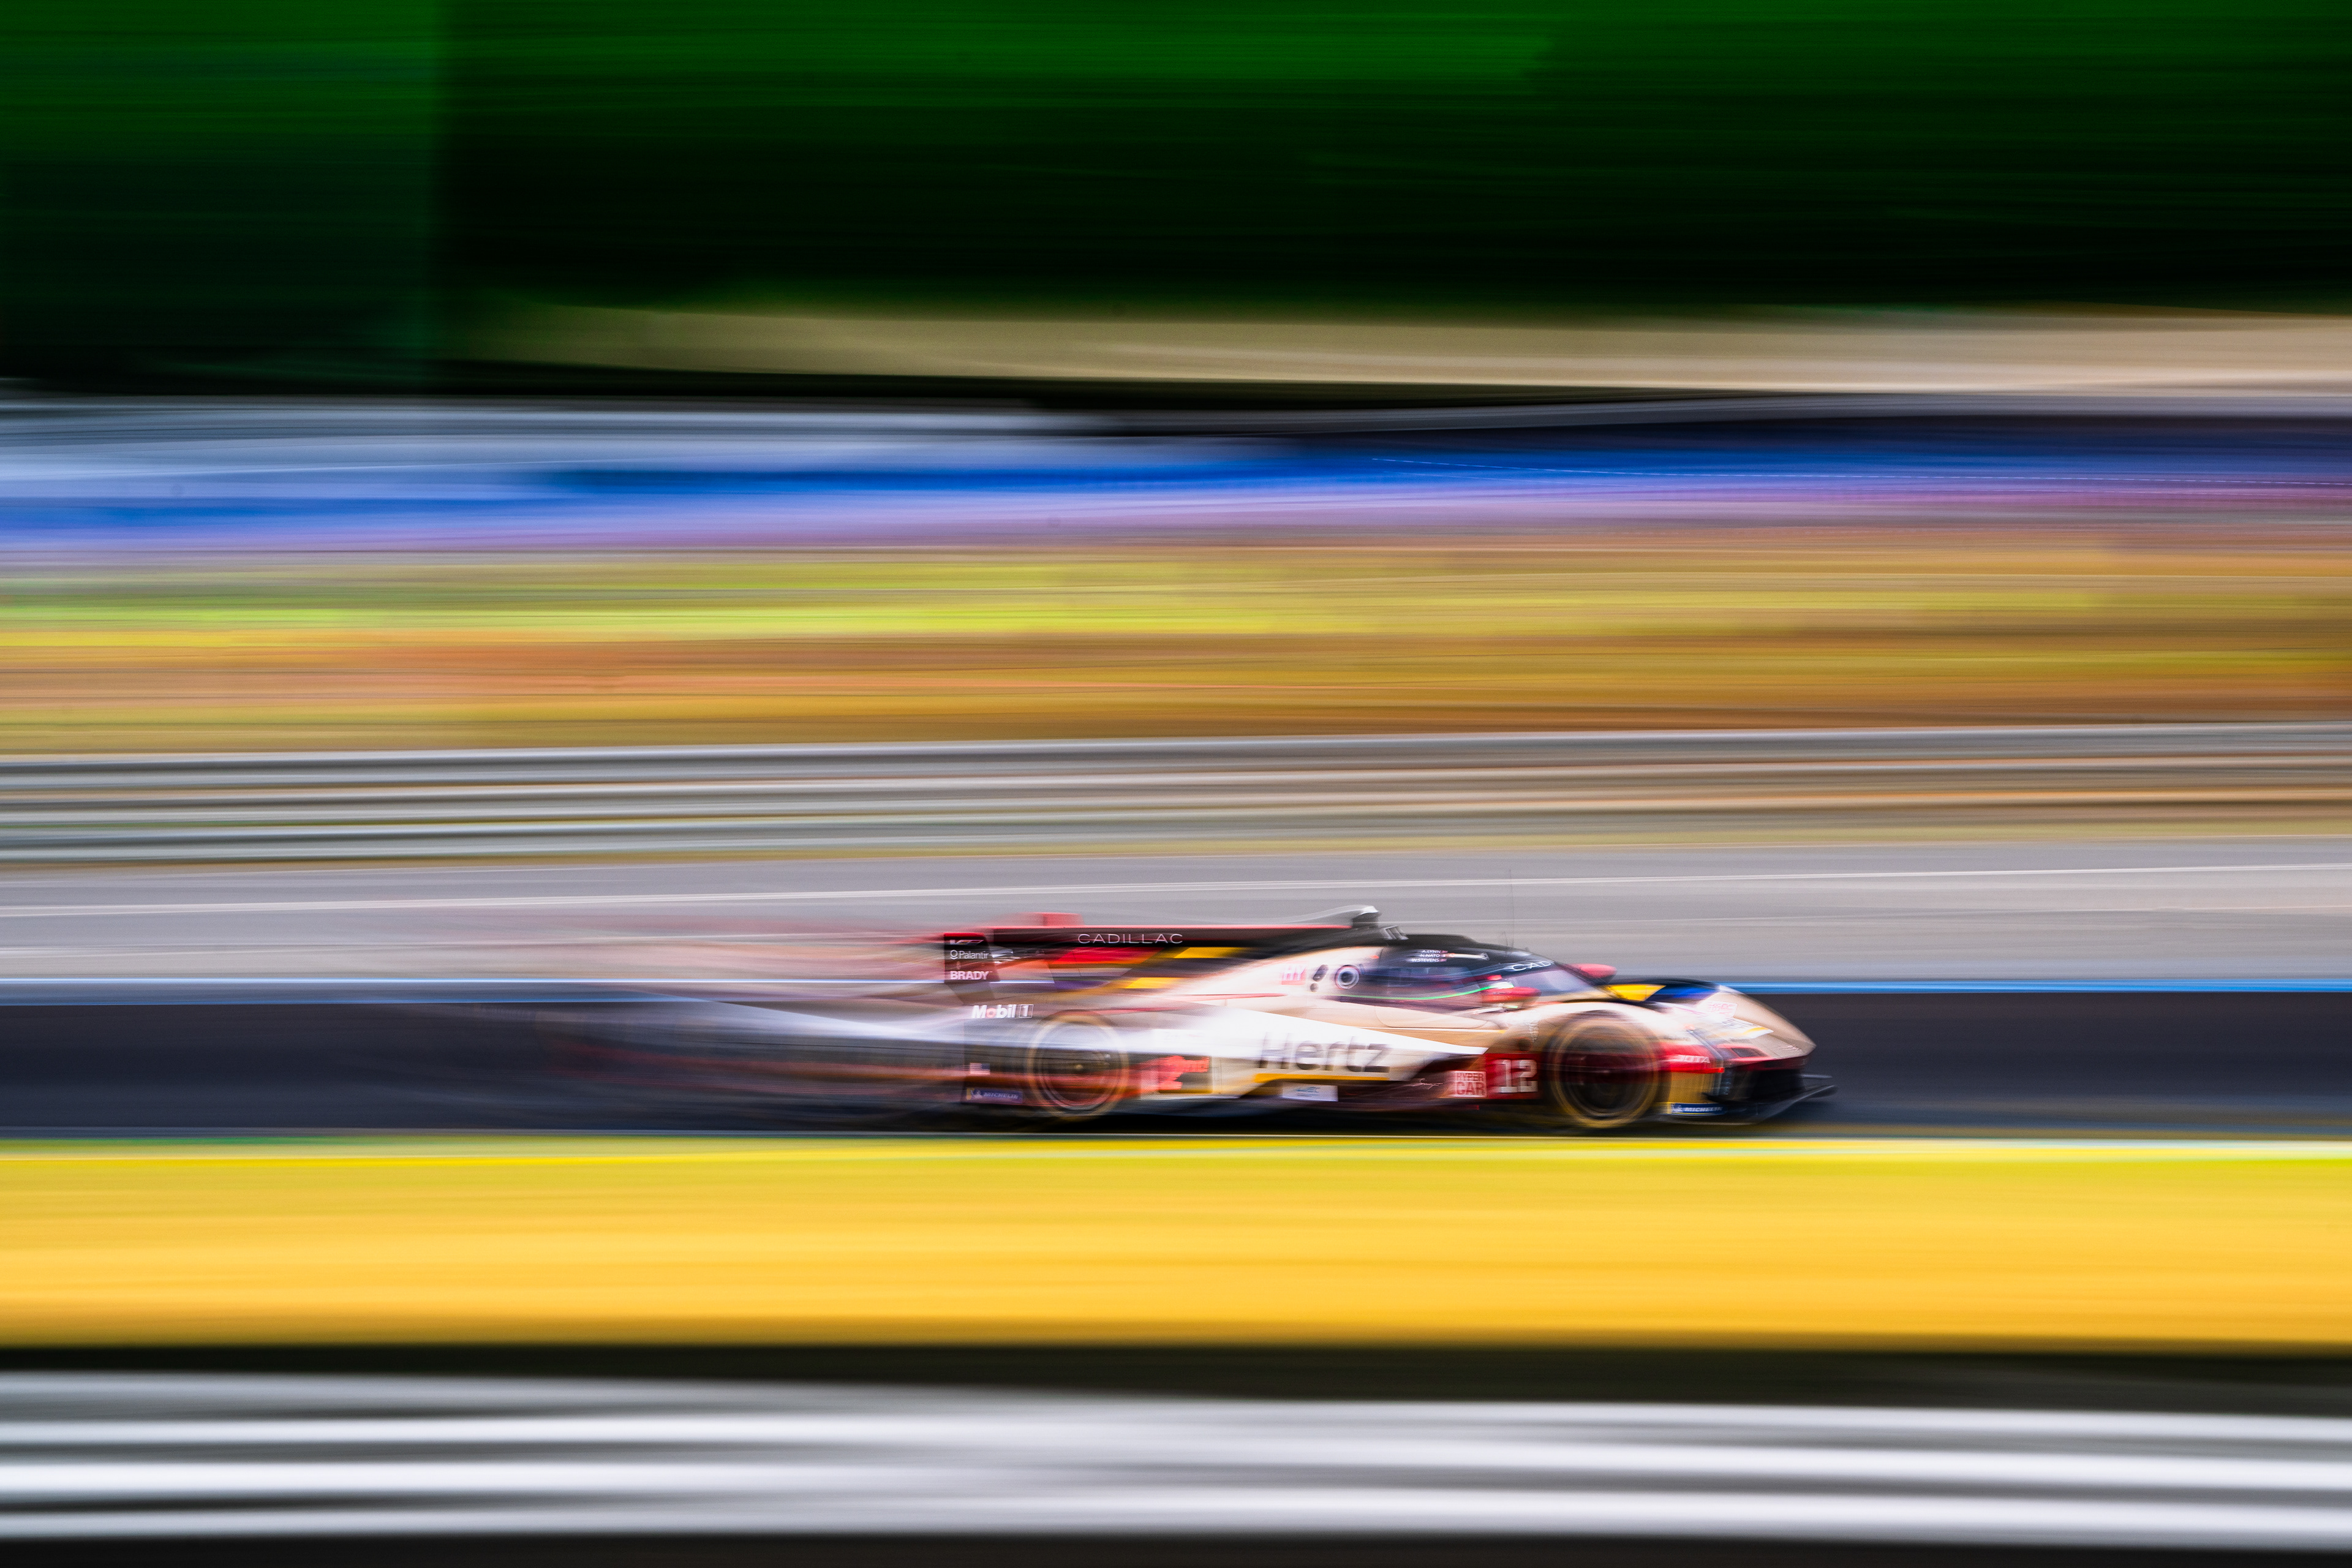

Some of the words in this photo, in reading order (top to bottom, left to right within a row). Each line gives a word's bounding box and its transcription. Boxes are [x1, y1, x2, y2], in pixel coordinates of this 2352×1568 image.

[1078, 933, 1183, 944] CADILLAC
[959, 951, 989, 959] Palantir
[950, 971, 989, 980] BRADY
[971, 1005, 1017, 1018] Mobil
[1258, 1031, 1392, 1073] Hertz
[1675, 1055, 1711, 1063] JOTA
[1457, 1072, 1484, 1082] HYPER
[1494, 1059, 1538, 1093] 12
[1456, 1082, 1485, 1096] CAR
